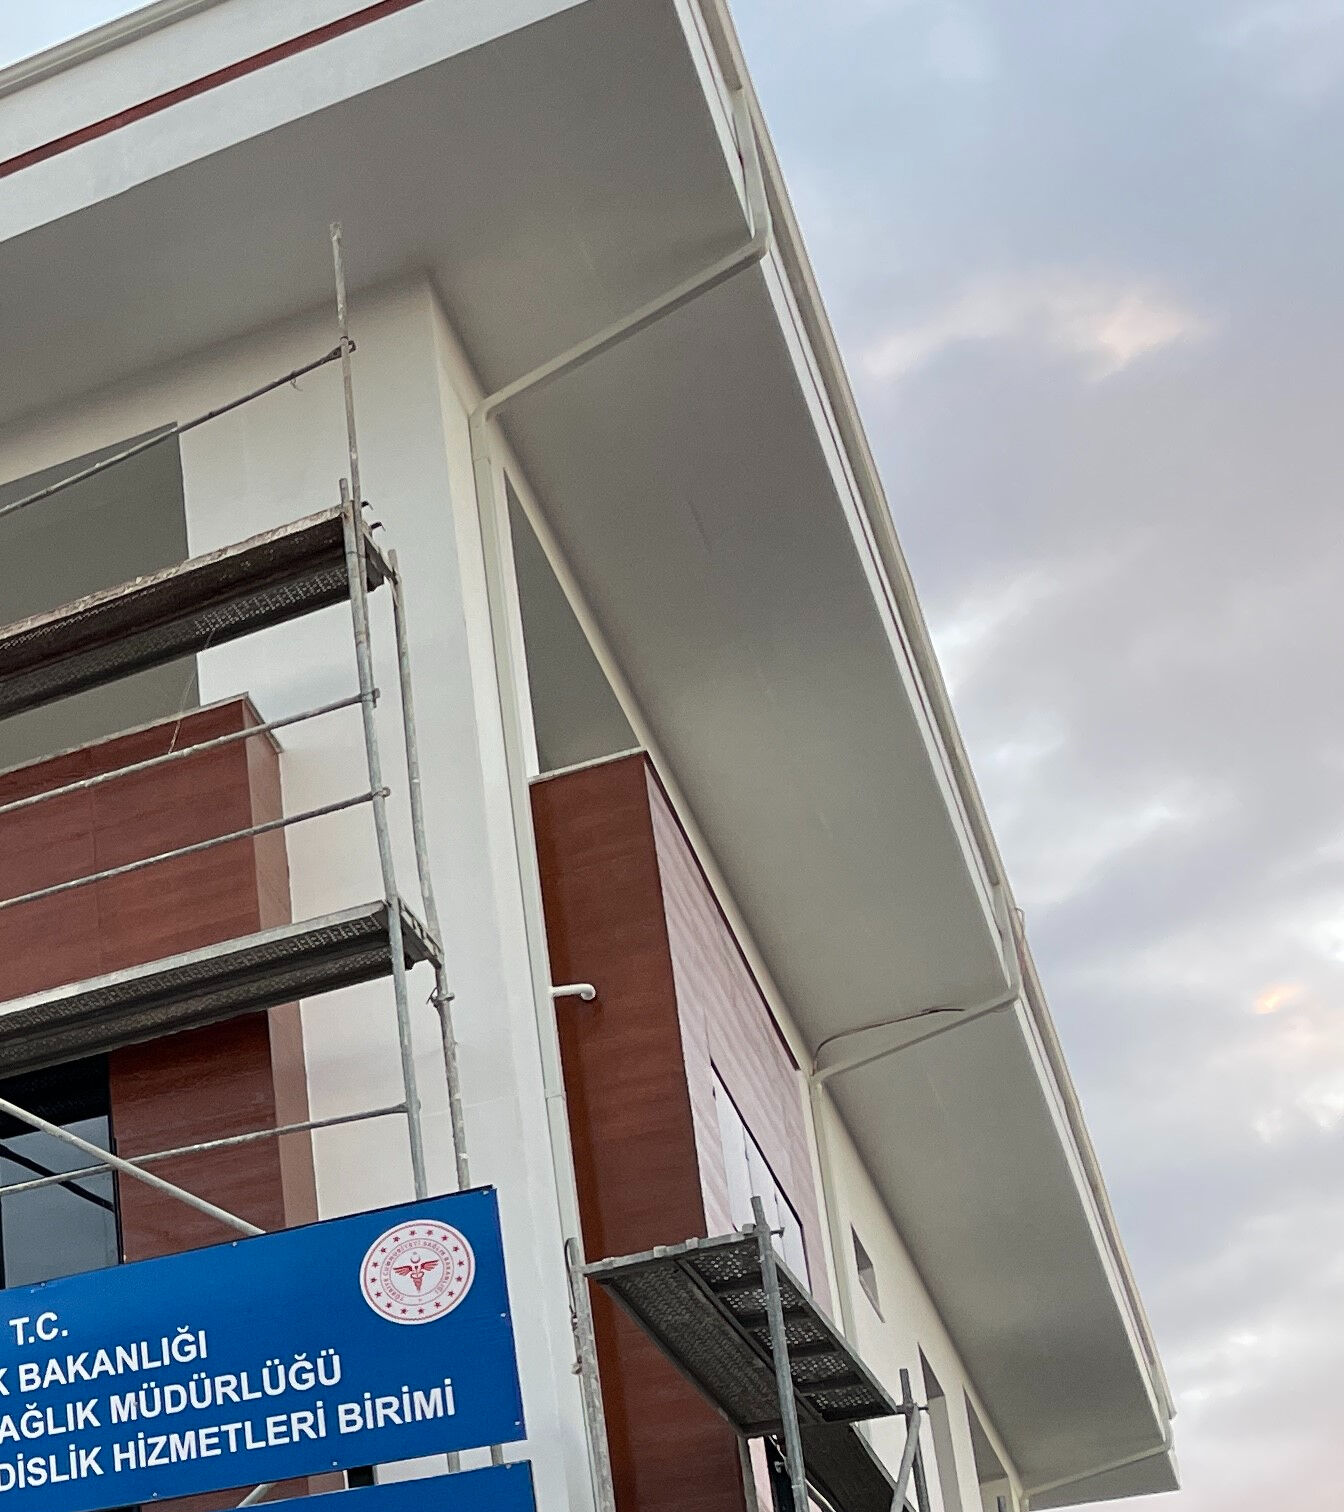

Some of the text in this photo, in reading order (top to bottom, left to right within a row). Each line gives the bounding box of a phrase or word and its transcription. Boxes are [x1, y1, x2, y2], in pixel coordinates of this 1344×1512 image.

[8, 1312, 68, 1346] T.C.
[18, 1325, 208, 1393] BAKANLIĞI
[109, 1348, 341, 1424] MÜDÜRLÜĞÜ
[113, 1400, 327, 1472] HİZMETLERİ
[337, 1378, 455, 1434] BİRİMİ
